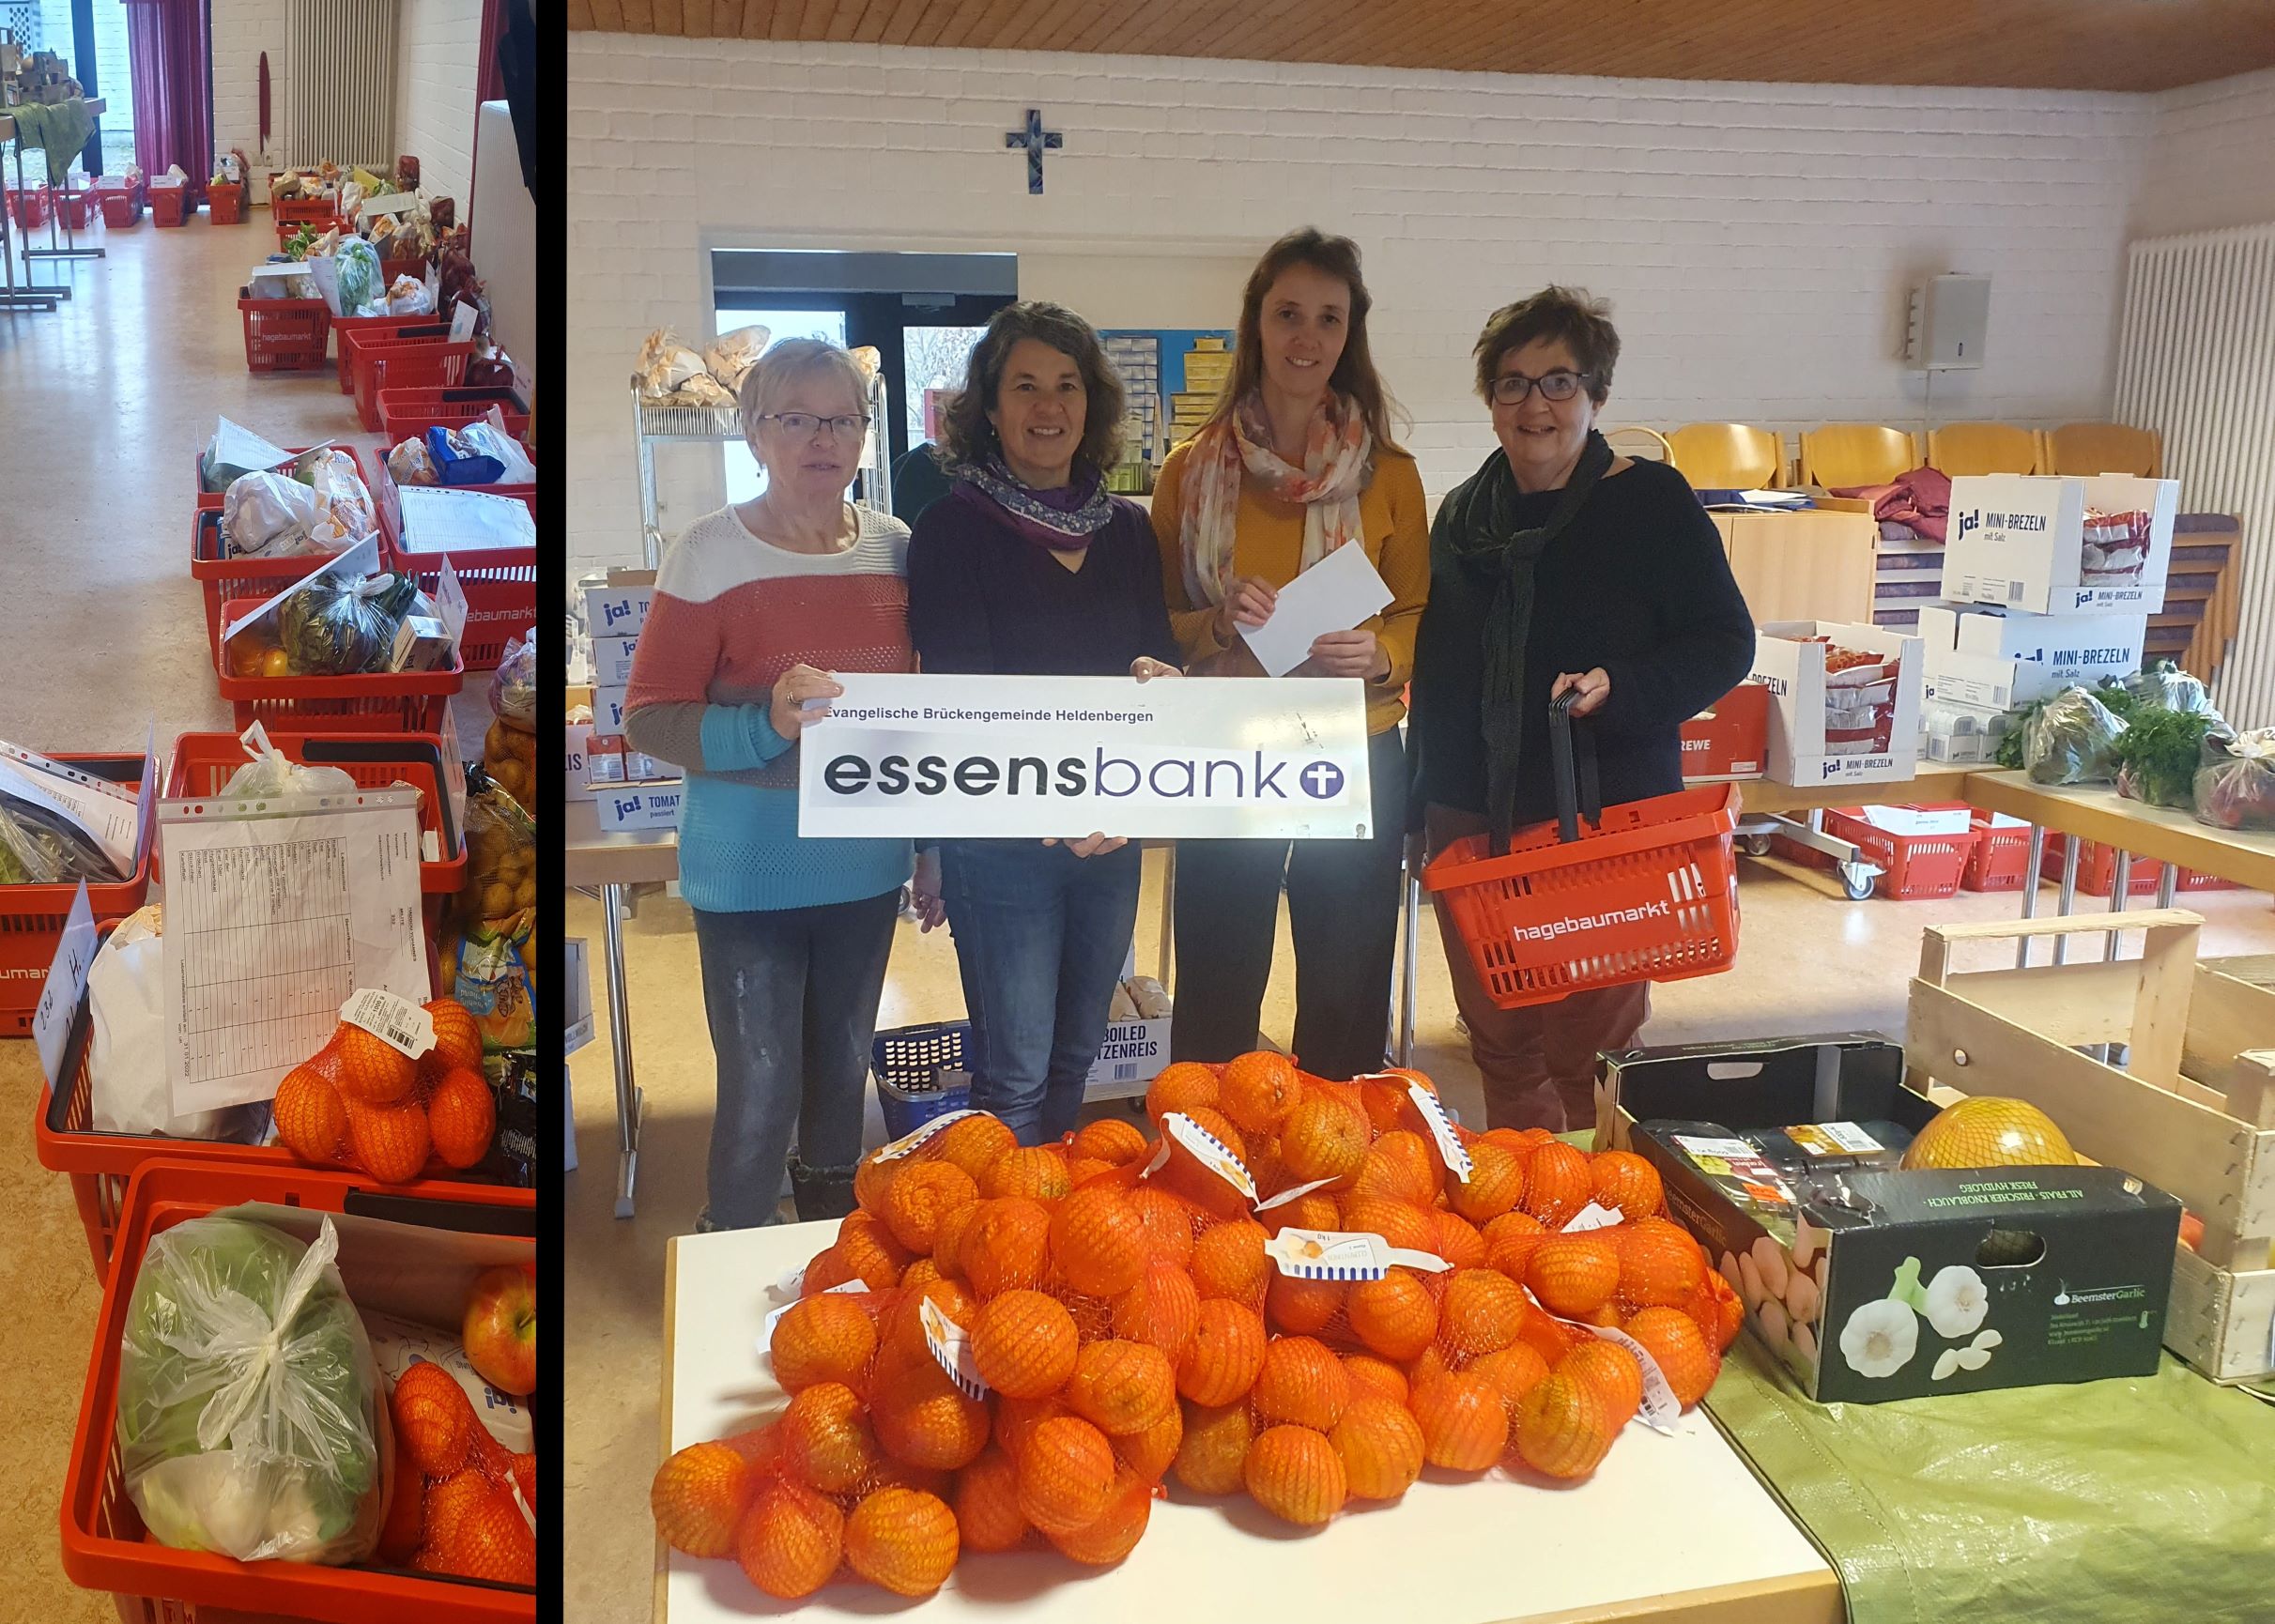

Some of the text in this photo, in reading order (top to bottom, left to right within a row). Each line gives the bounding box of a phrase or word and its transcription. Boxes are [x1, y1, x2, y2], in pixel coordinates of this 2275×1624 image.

[262, 331, 312, 343] hagebaumarkt
[1959, 509, 2046, 541] ja! MINI-BREZELN
[1994, 531, 2006, 542] Salz
[2075, 590, 2143, 608] ja! MINI-BREZELN
[604, 600, 631, 626] ja!
[623, 639, 638, 656] ja
[2052, 648, 2129, 666] MINI-BREZELN
[2052, 668, 2080, 679] mit Salz
[824, 706, 1154, 724] Evangelische Brückengemeinde Heldenbergen
[1681, 739, 1711, 751] REWE
[823, 747, 1287, 798] essensbank
[1822, 758, 1894, 779] ja! MINI-BREZELN
[614, 795, 681, 821] ja! TOMAT
[650, 809, 675, 819] passiert
[1513, 900, 1669, 942] hagebaumarkt
[1959, 1181, 2038, 1193] FRESK HVIDLOEG
[1928, 1193, 1990, 1208] KNOBLAUCH
[1991, 1192, 2036, 1203] FRISCHER
[2041, 1191, 2067, 1201] FRAIS
[2071, 1288, 2145, 1304] BeemsterGarlic
[484, 1387, 517, 1415] ja!
